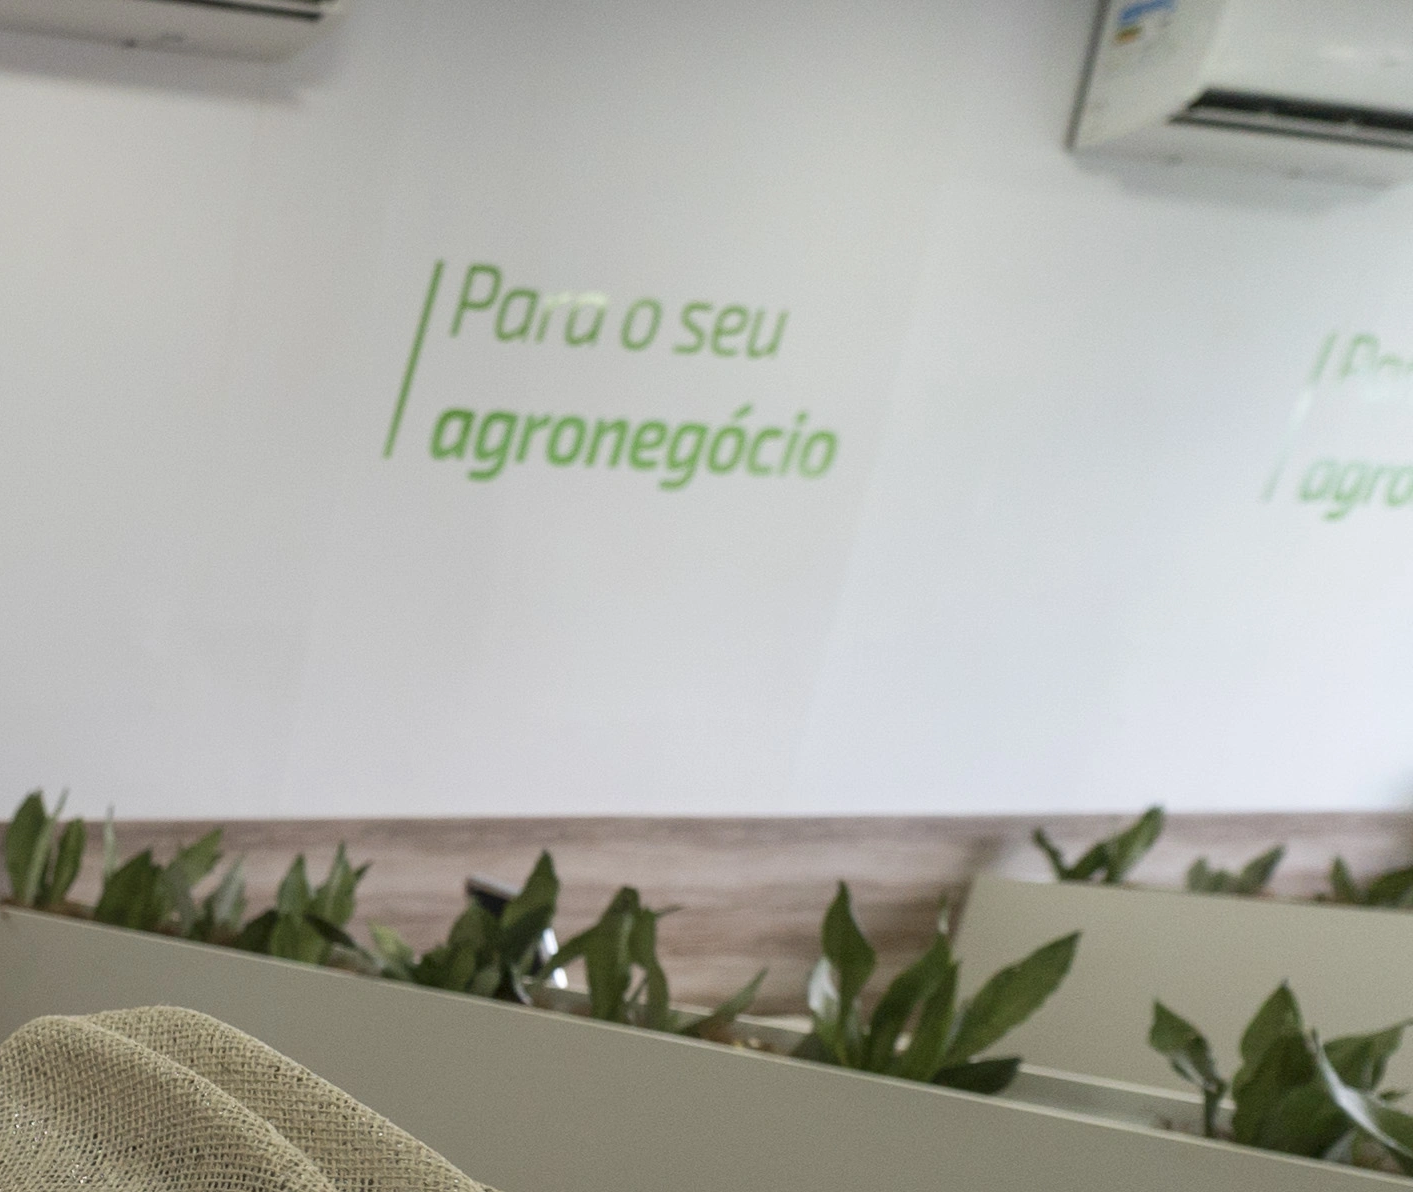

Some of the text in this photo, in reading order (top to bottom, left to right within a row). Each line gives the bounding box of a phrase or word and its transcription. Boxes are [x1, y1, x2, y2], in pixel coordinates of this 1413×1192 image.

[449, 262, 790, 360] Para o seu
[429, 402, 839, 491] agronegócio
